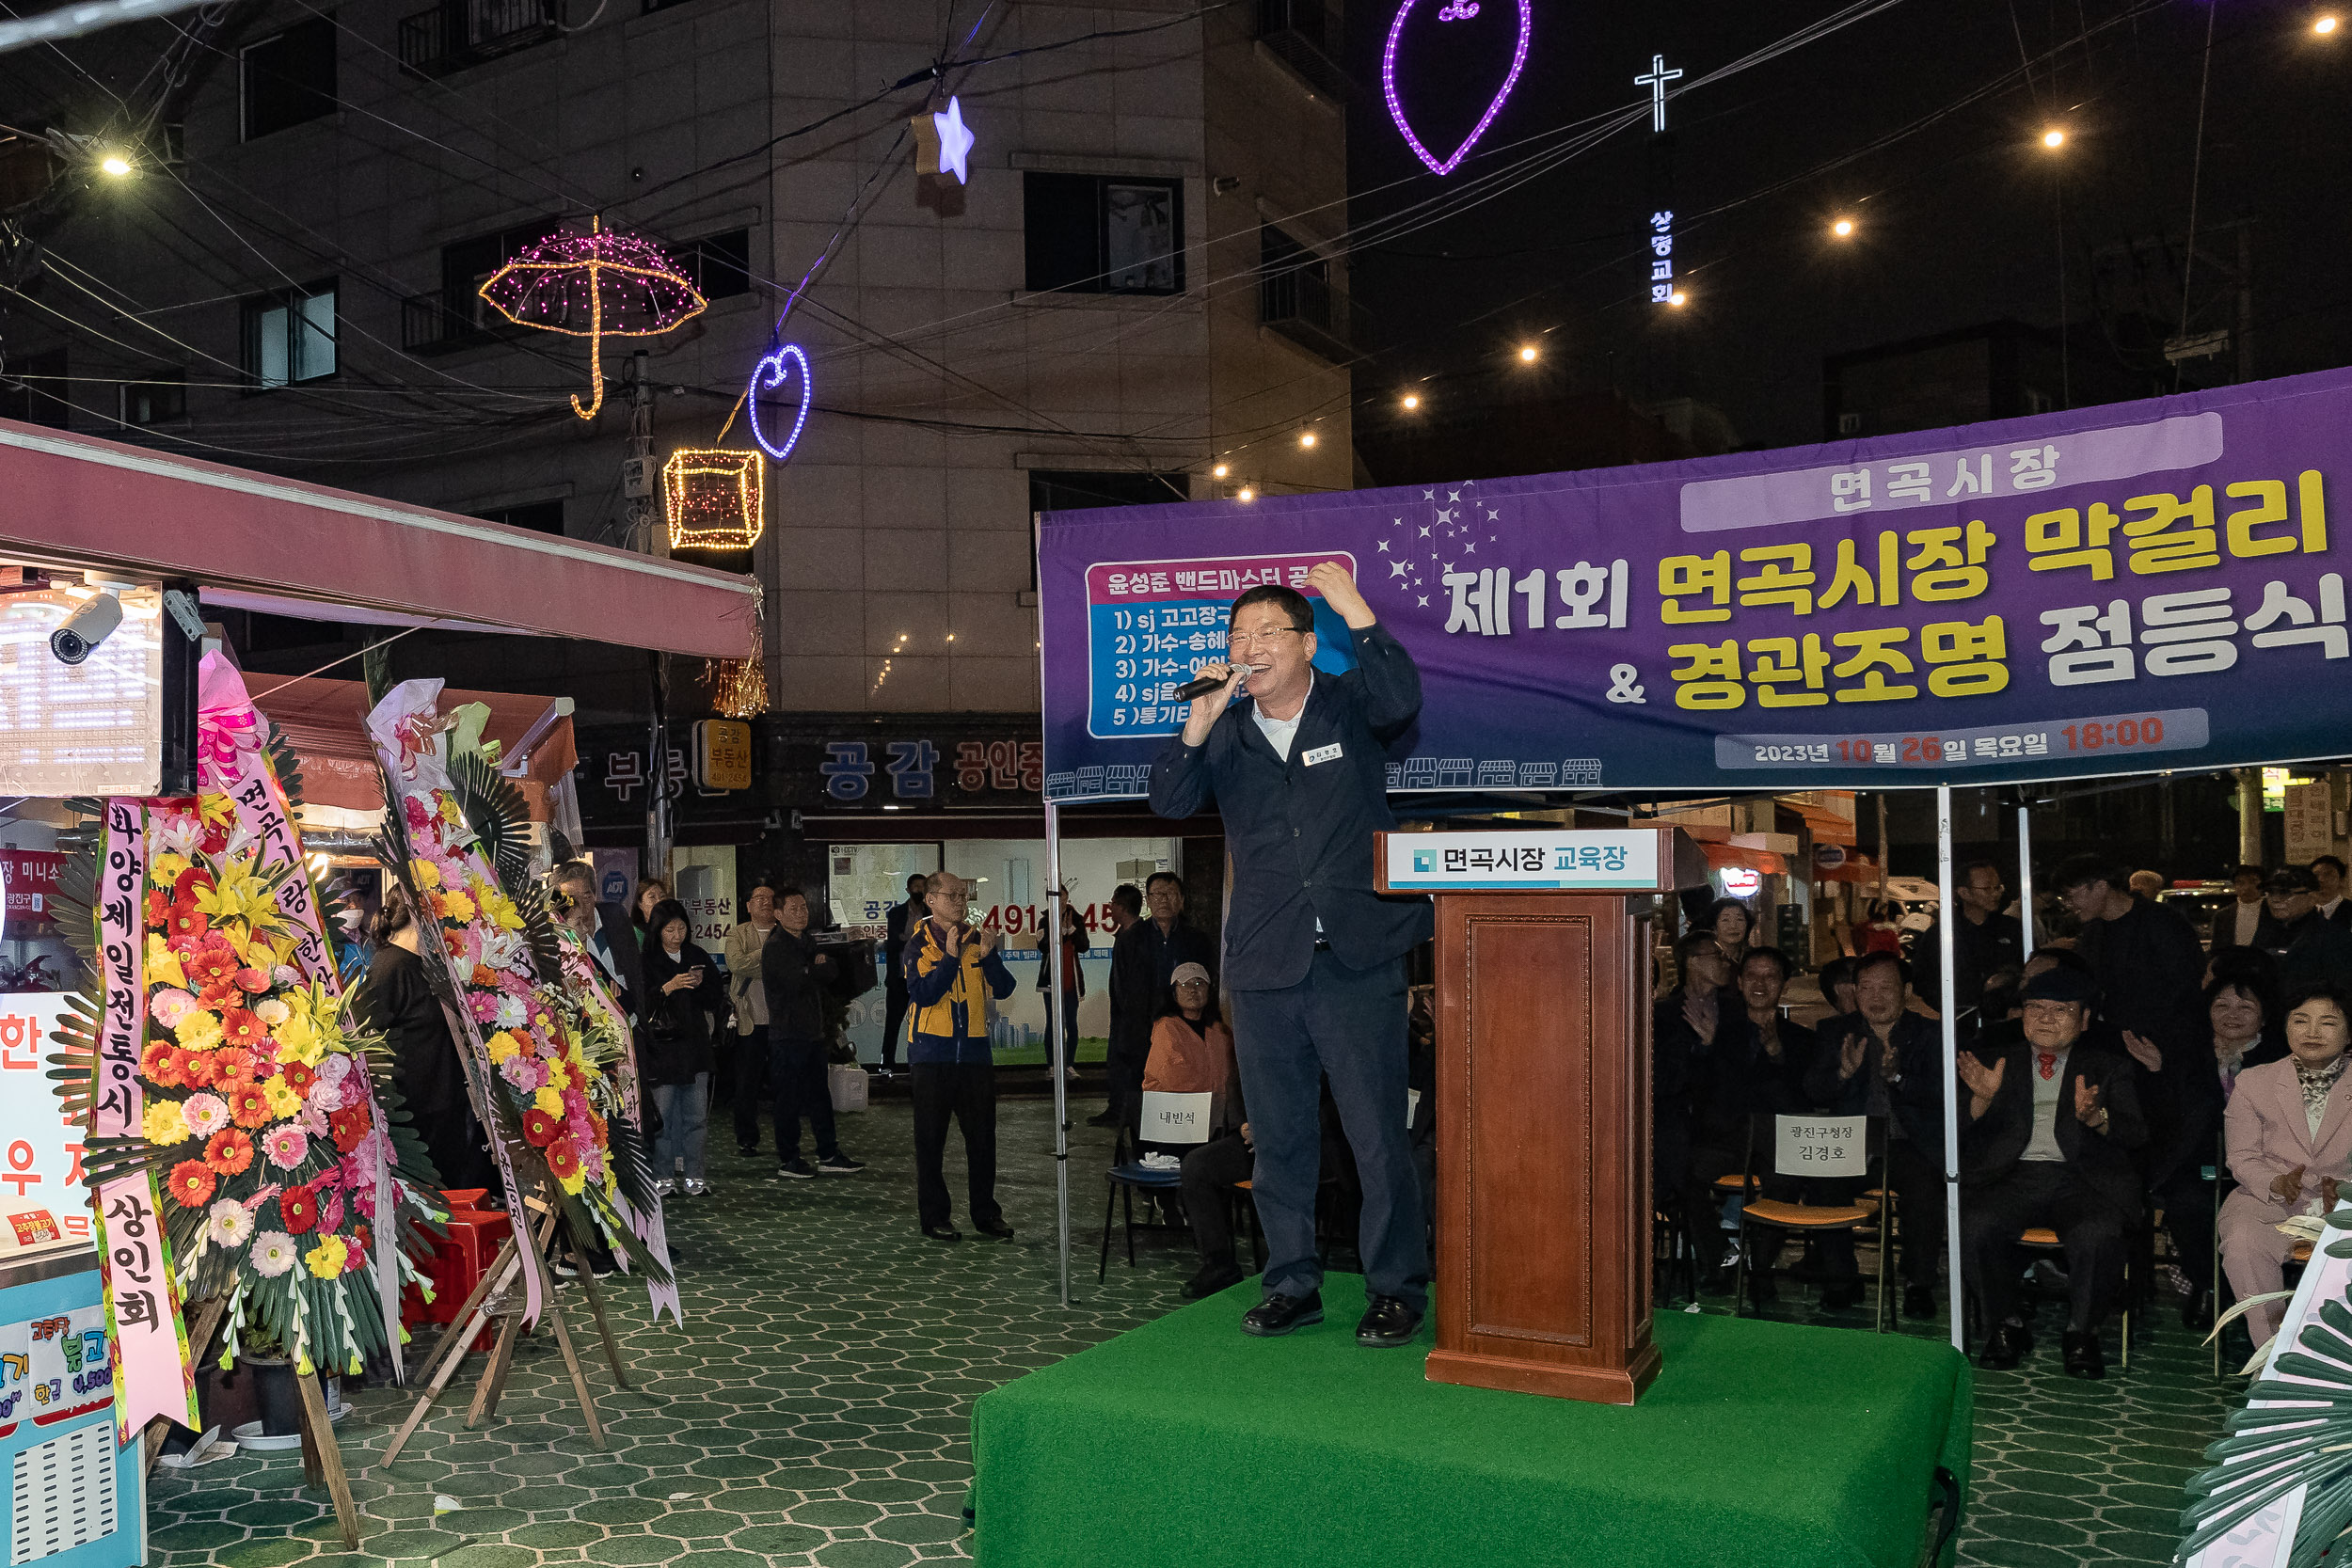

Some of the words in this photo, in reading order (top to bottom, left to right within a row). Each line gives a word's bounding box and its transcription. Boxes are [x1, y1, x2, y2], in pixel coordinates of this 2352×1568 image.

[1831, 444, 2060, 513] 면곡시장
[1442, 559, 1629, 636] 제1회
[1658, 520, 1996, 626] 면곡시장
[2024, 469, 2328, 581] 막걸리
[1107, 572, 1171, 595] 윤성준
[1175, 566, 1281, 593] 밴드마스터
[1288, 565, 1310, 590] 공
[1114, 610, 1132, 630] 1)
[1137, 610, 1155, 632] sj
[1115, 634, 1136, 655] 2)
[1141, 630, 1228, 653] 가수-송혜
[1605, 663, 1646, 705] &
[1667, 614, 2010, 710] 경관조명
[2040, 573, 2351, 687] 점등식
[1115, 658, 1136, 679] 3)
[1114, 683, 1136, 703] 4)
[1141, 680, 1191, 705] sj음
[718, 724, 742, 745] 공감
[1755, 743, 1830, 763] 2023년
[1836, 738, 1897, 764] 10월
[1901, 736, 1968, 763] 26일
[1974, 731, 2049, 759] 목요일
[2061, 717, 2164, 752] 18:00
[710, 747, 748, 769] 부동산
[819, 739, 940, 800] 공감
[953, 740, 1043, 792] 공인중
[605, 749, 696, 801] 부동
[1, 861, 14, 884] 장
[22, 862, 60, 881] 미니소
[1444, 847, 1546, 873] 면곡시장
[1553, 846, 1629, 872] 교육장
[7, 893, 31, 905] 광진구
[863, 925, 888, 940] 인중
[97, 804, 143, 1180] 화양제일전통시
[1159, 1111, 1195, 1125] 내빈석
[1790, 1126, 1854, 1139] 광진구청장
[1799, 1146, 1847, 1162] 김경호
[14, 1217, 56, 1233] 고추장불고기
[104, 1194, 160, 1334] 상인회
[61, 1329, 107, 1373] 불고
[0, 1353, 29, 1389] 기
[73, 1356, 113, 1395] 4,500
